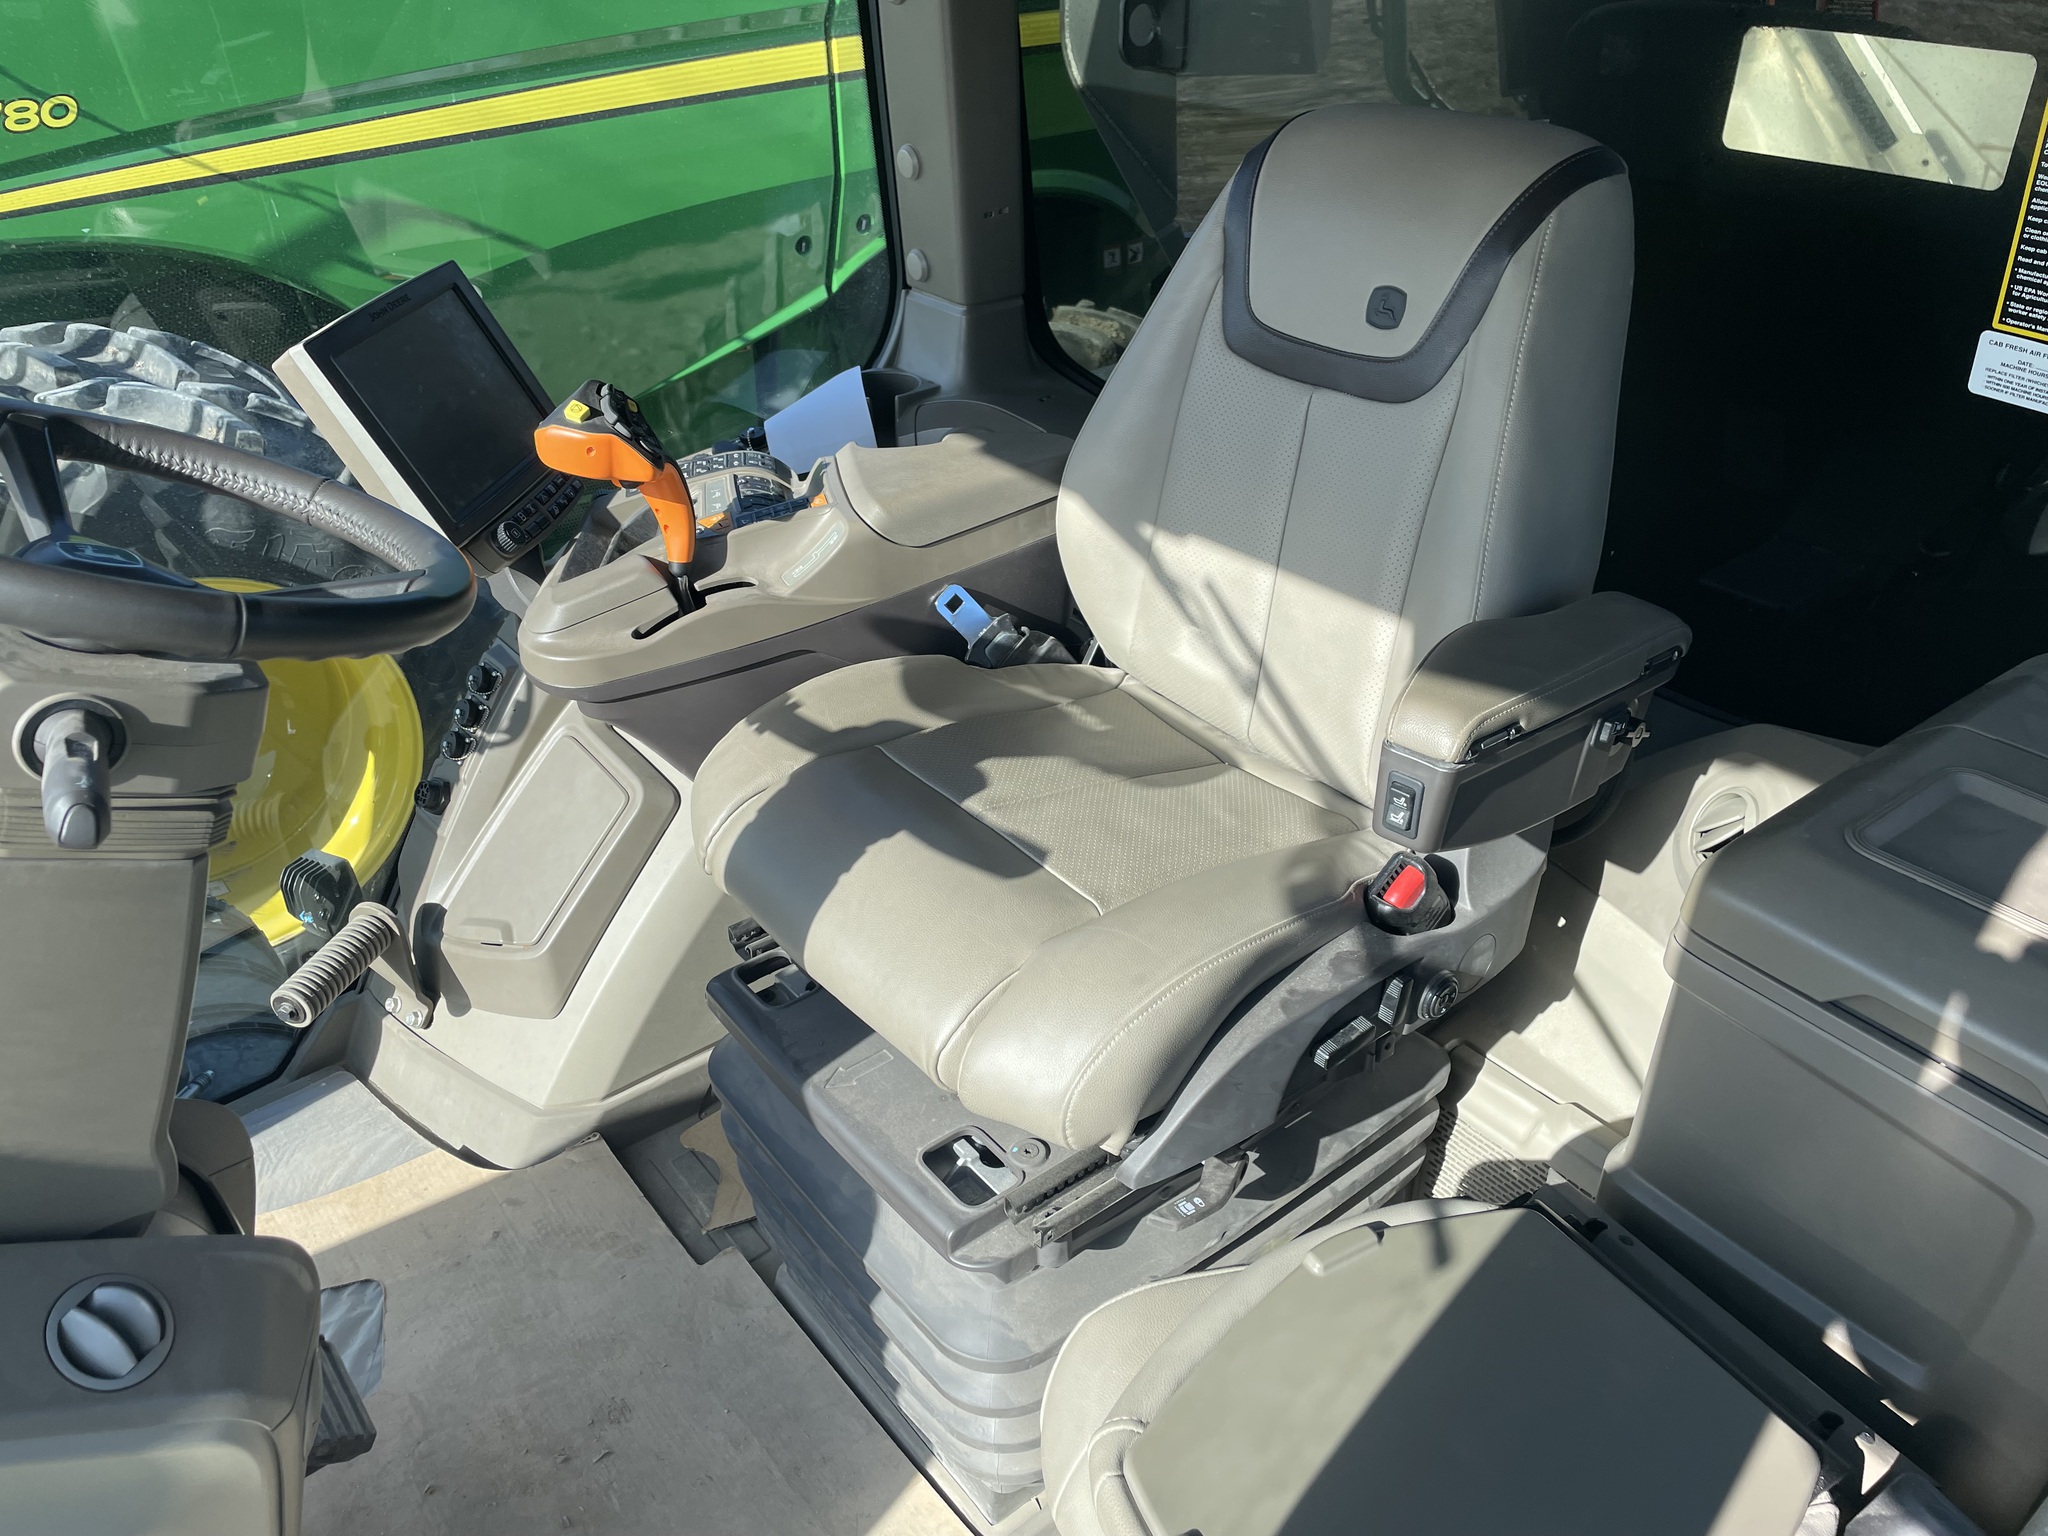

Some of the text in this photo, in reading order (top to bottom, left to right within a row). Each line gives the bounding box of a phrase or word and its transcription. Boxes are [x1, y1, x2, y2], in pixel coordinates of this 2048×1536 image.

[0, 94, 79, 134] 80
[2016, 274, 2042, 283] chemical
[1989, 339, 2003, 348] CAB
[2005, 343, 2028, 354] FRESH
[2029, 349, 2041, 357] AIR
[1985, 367, 2008, 376] REPLACE
[2008, 373, 2025, 381] FILTER
[2001, 362, 2027, 373] MACHINE
[1984, 385, 2004, 393] SOONER
[2009, 391, 2025, 399] FILTER
[2010, 385, 2032, 396] MACHINE
